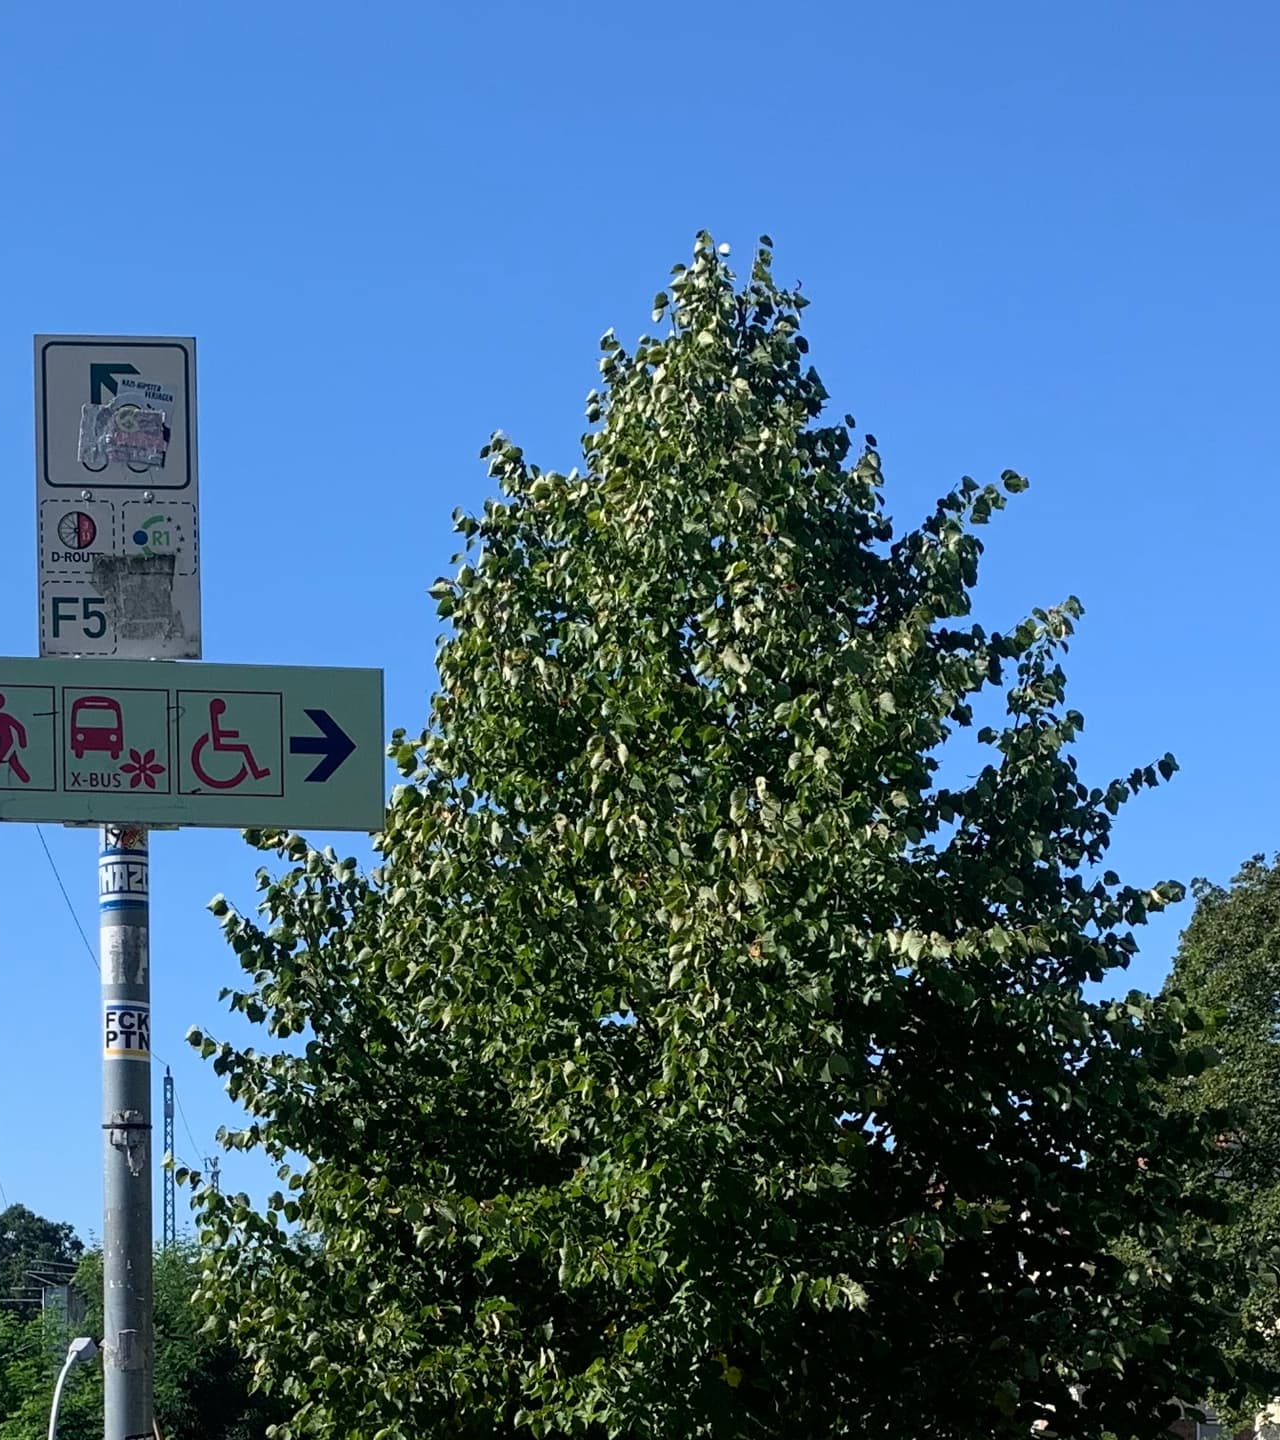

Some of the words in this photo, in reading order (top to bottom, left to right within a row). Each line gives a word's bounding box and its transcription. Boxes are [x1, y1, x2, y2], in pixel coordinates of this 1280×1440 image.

[152, 530, 170, 546] R1
[51, 551, 105, 563] D-ROUT
[51, 596, 107, 639] F5
[71, 771, 122, 788] X-BUS
[106, 1011, 150, 1033] FCK
[106, 1030, 150, 1052] PTN
